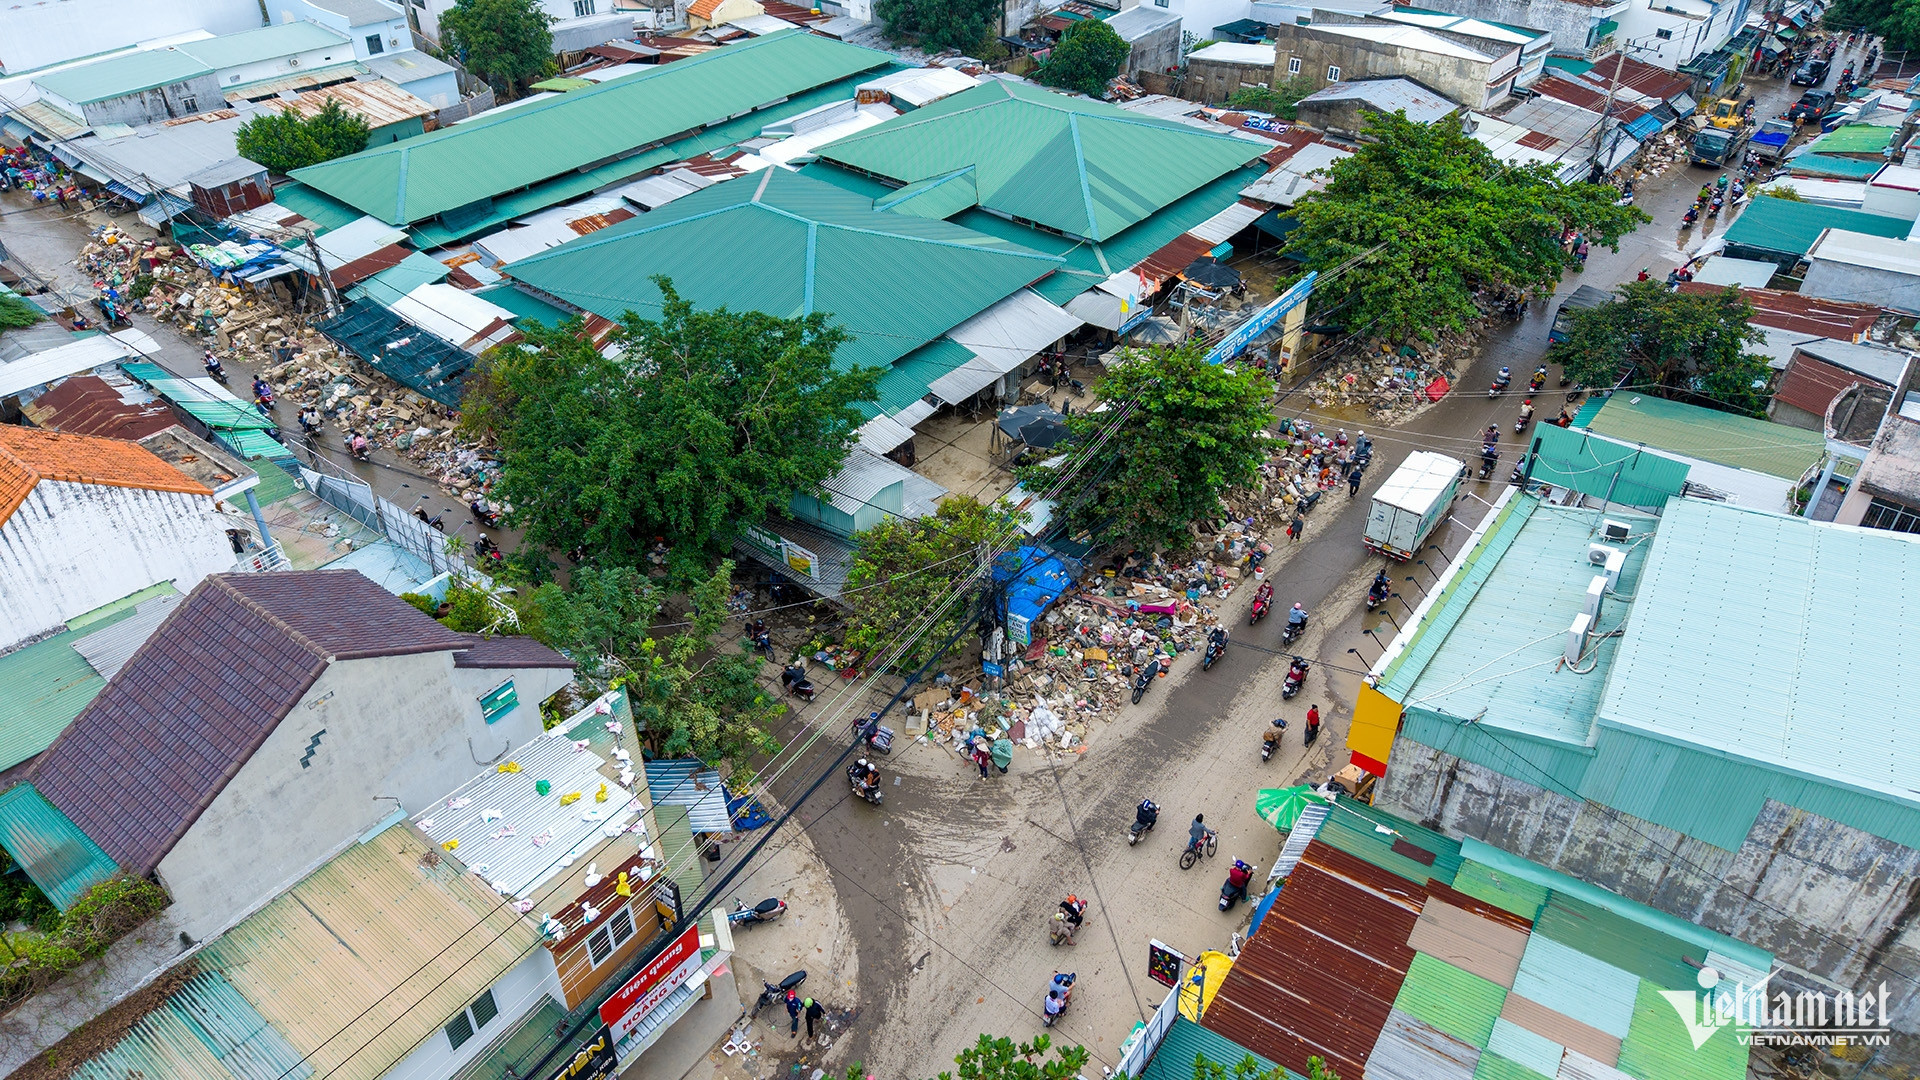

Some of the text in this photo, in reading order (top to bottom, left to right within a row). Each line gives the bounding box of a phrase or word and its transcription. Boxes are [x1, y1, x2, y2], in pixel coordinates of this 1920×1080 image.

[648, 943, 683, 976] quang
[622, 968, 687, 1030] HOÀNG VŨ
